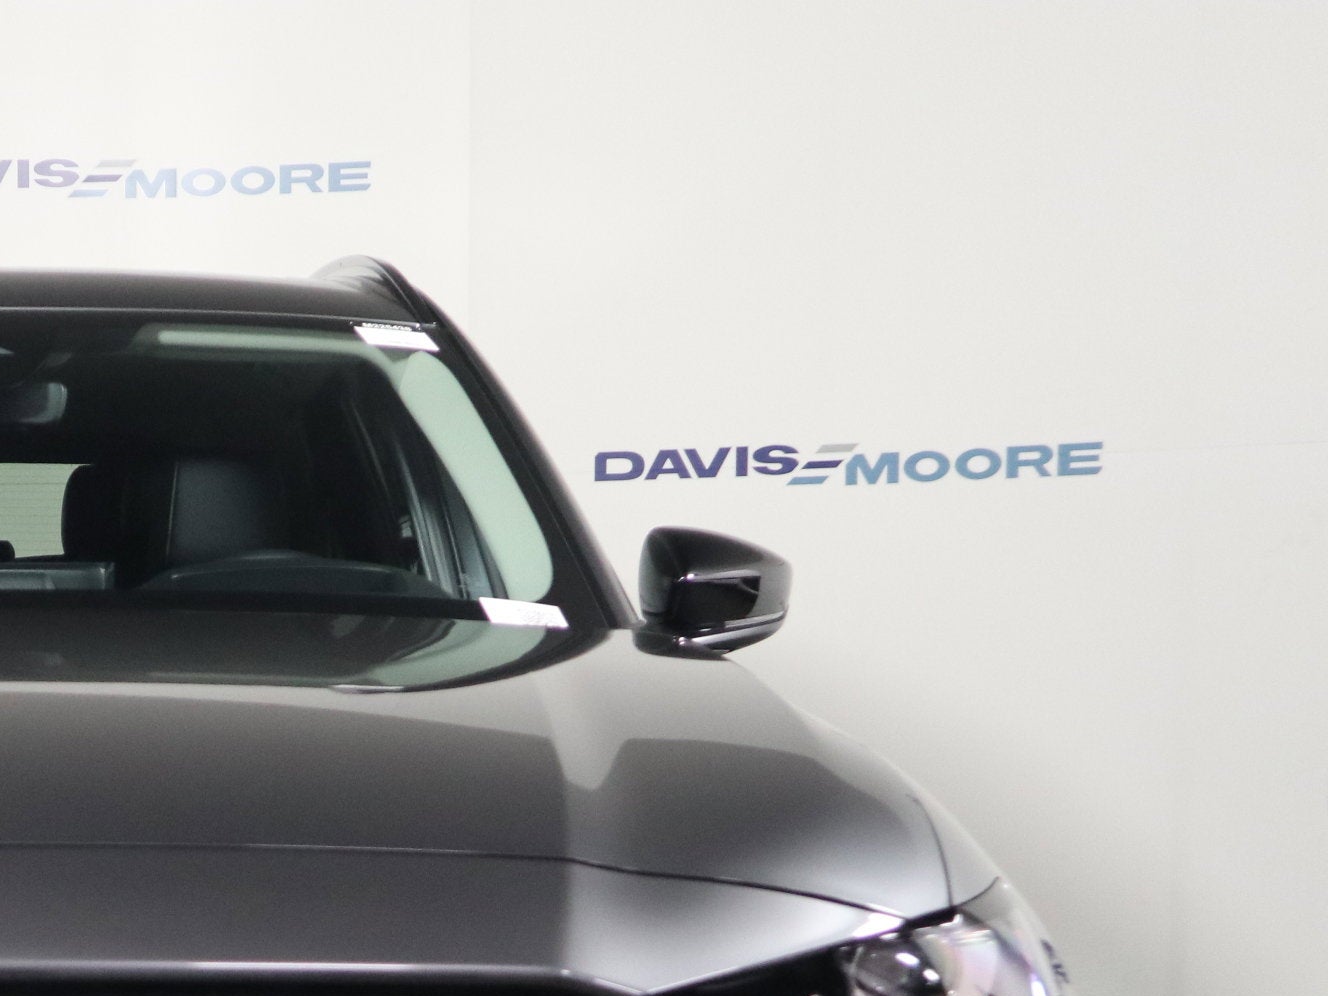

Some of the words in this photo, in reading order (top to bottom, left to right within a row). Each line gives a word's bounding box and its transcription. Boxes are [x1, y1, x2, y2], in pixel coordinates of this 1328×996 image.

[125, 160, 371, 199] MOORE
[593, 443, 800, 482] DAVIS
[844, 441, 1104, 486] MOORE
